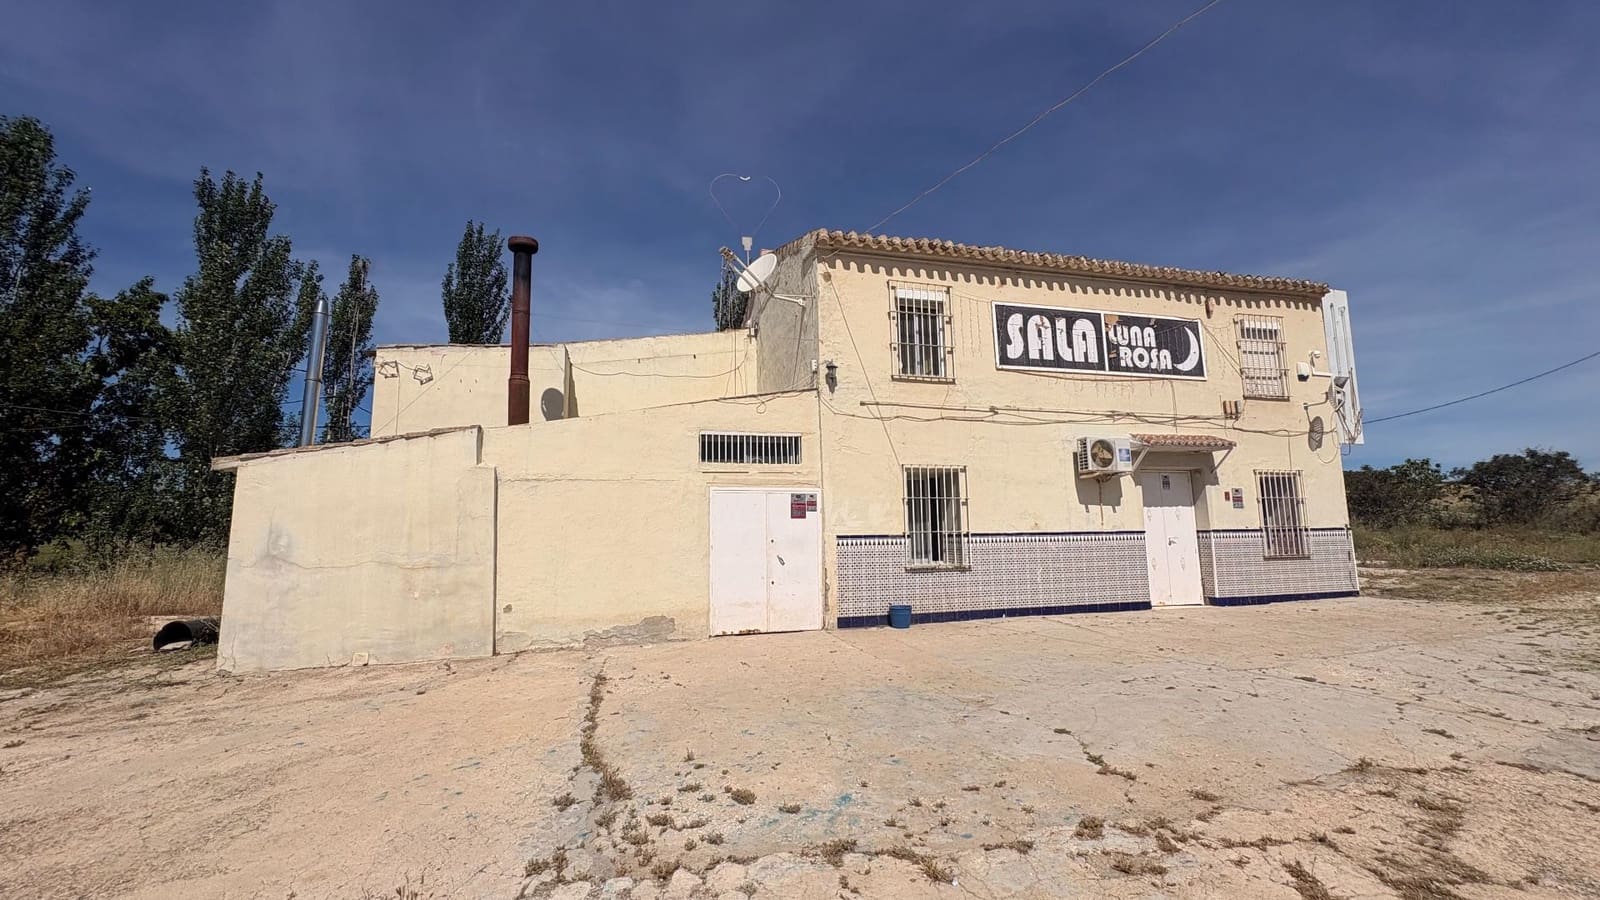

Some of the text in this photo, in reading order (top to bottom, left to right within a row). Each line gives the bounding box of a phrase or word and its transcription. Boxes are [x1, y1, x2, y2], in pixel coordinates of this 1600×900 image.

[1006, 313, 1099, 363] SALA
[1108, 324, 1157, 348] LUNA
[1119, 347, 1173, 370] ROSA
